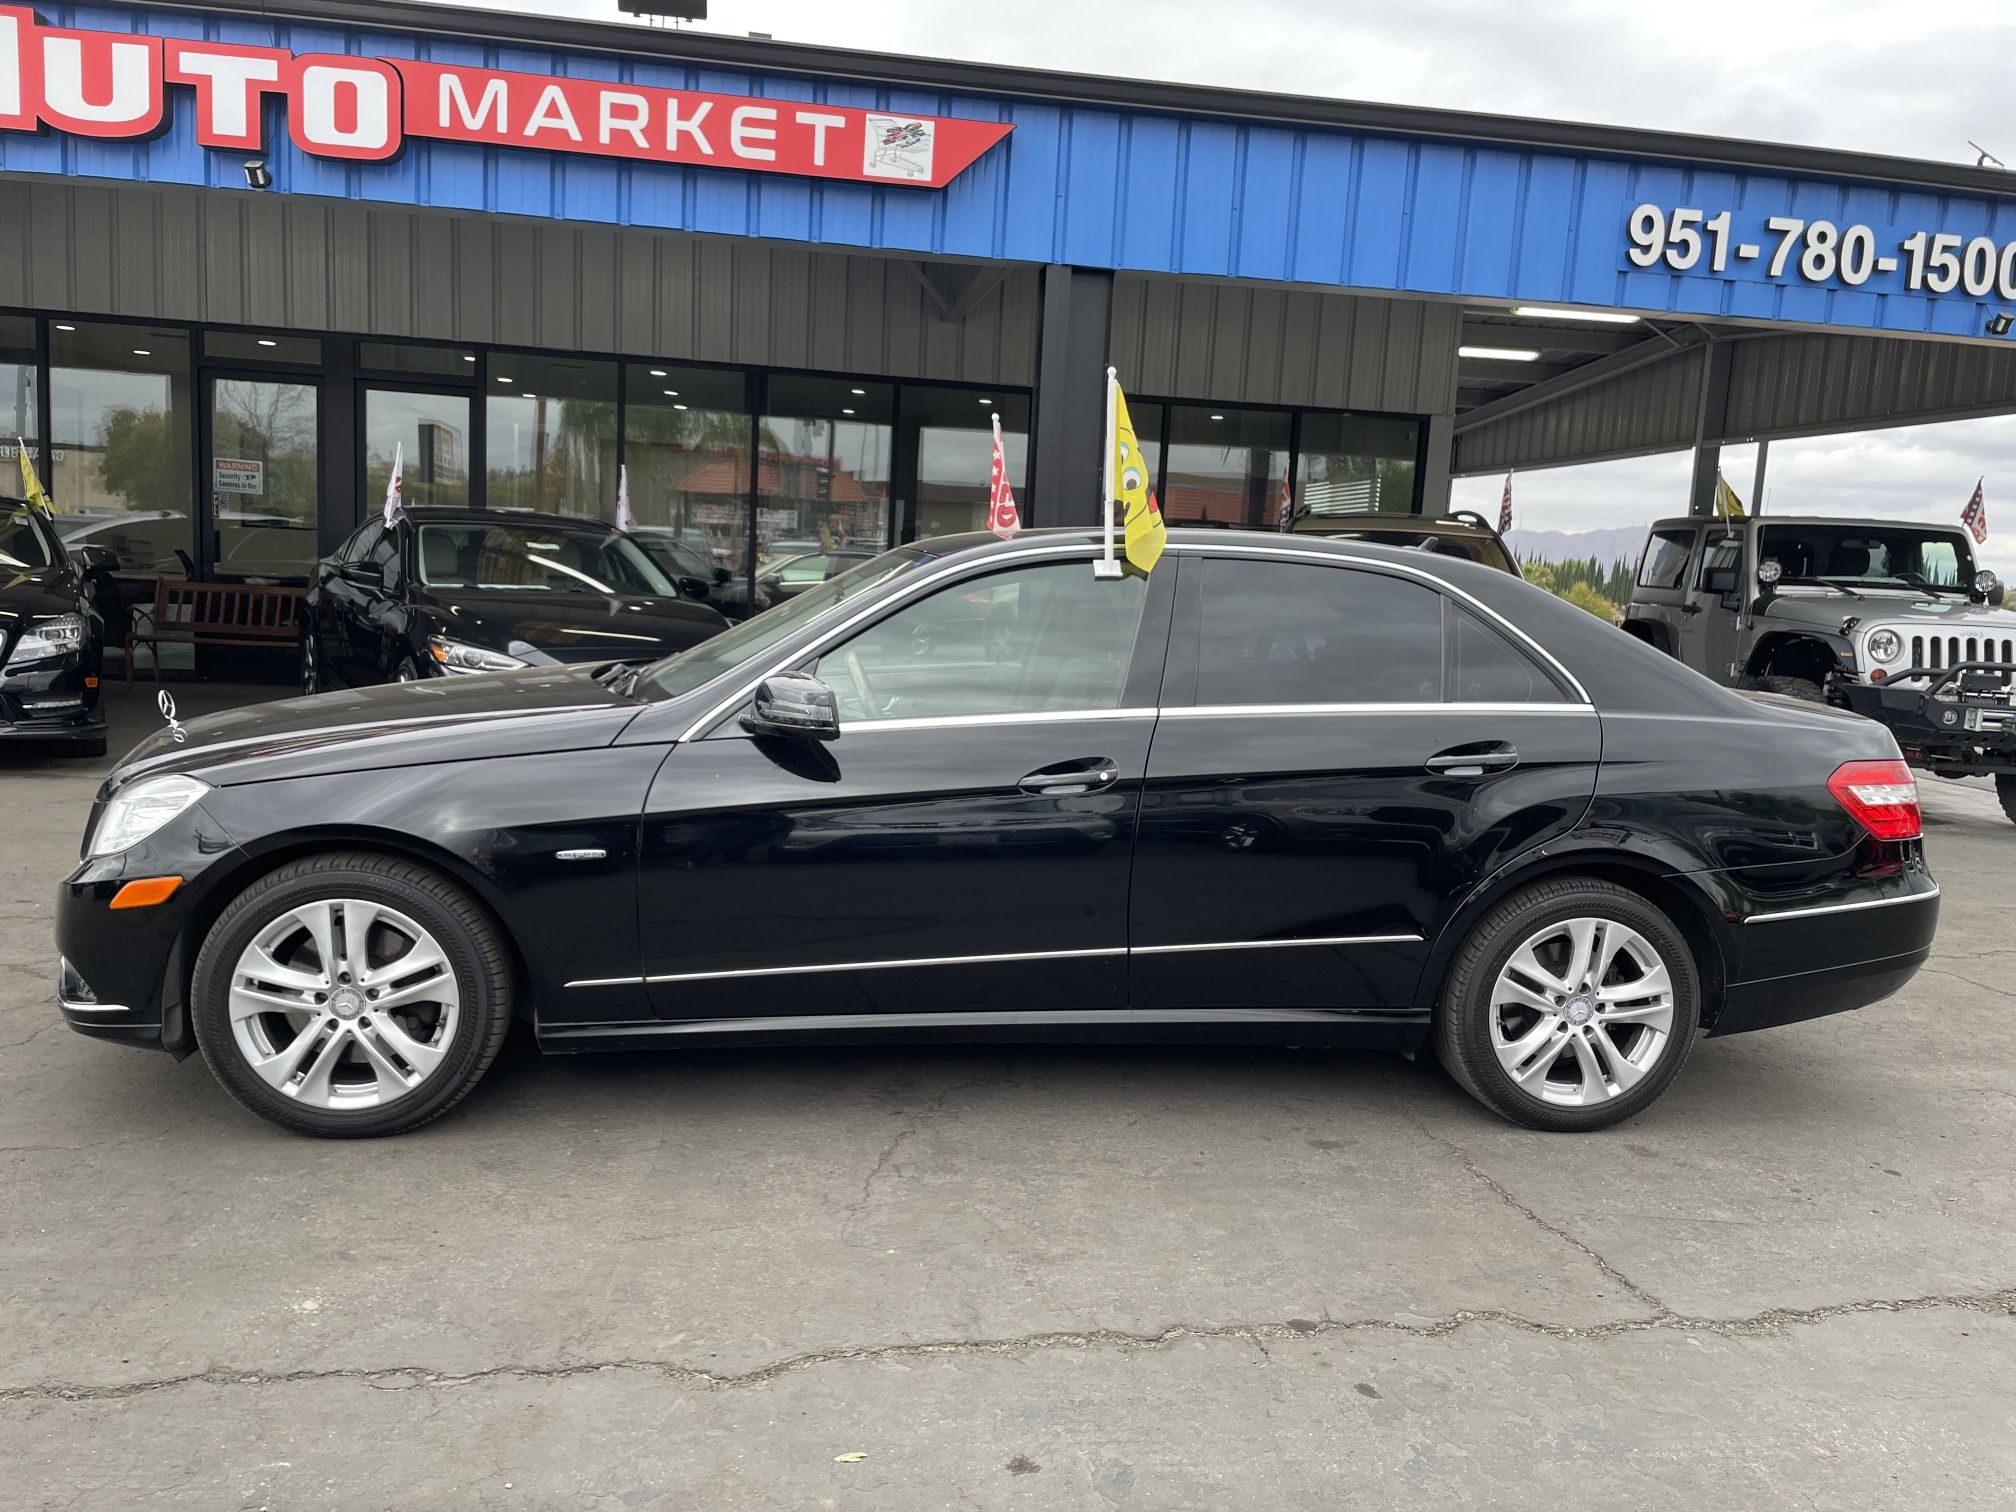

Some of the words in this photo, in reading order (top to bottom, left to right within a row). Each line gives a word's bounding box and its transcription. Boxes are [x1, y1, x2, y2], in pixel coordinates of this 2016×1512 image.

[0, 15, 388, 149] UTO
[438, 73, 846, 167] MARKET
[1628, 203, 2016, 301] 951-780-1500
[218, 461, 258, 472] WARNING
[219, 472, 241, 482] Security
[219, 479, 241, 489] Cameras
